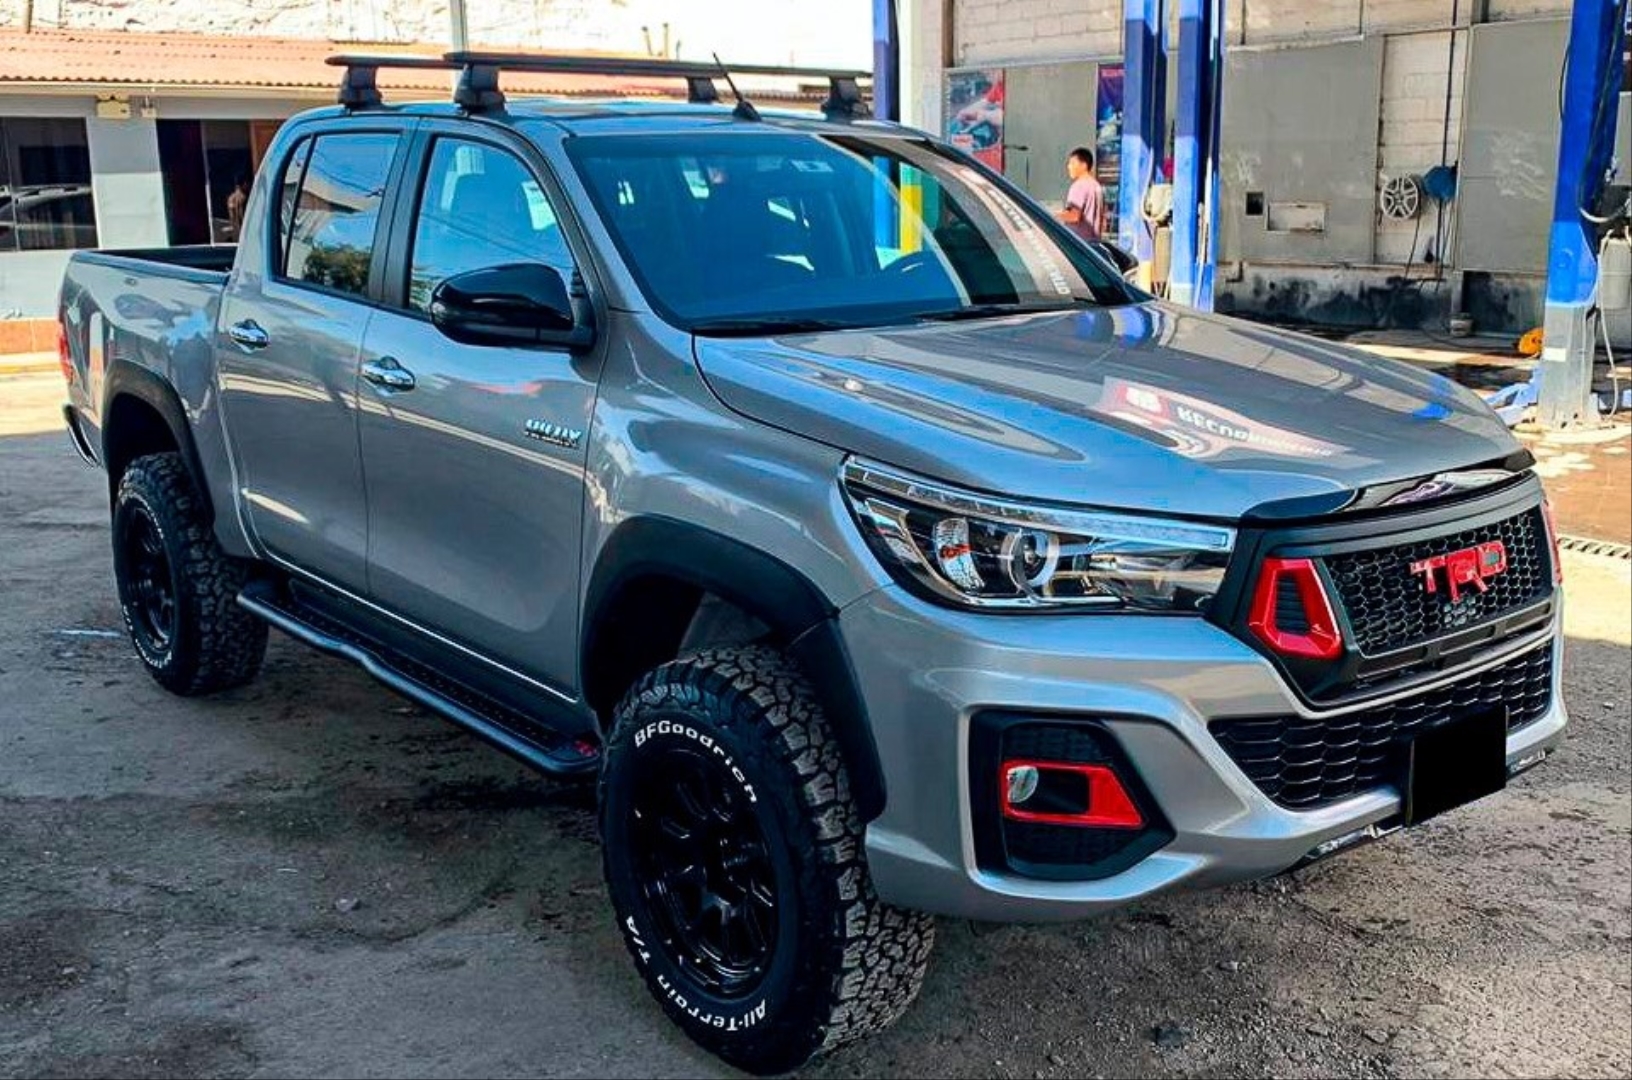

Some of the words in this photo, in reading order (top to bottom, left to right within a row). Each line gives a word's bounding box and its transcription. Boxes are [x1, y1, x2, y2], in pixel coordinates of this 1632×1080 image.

[1409, 541, 1506, 604] TRD
[634, 720, 757, 803] BFGoodrich
[626, 915, 651, 964] T/A
